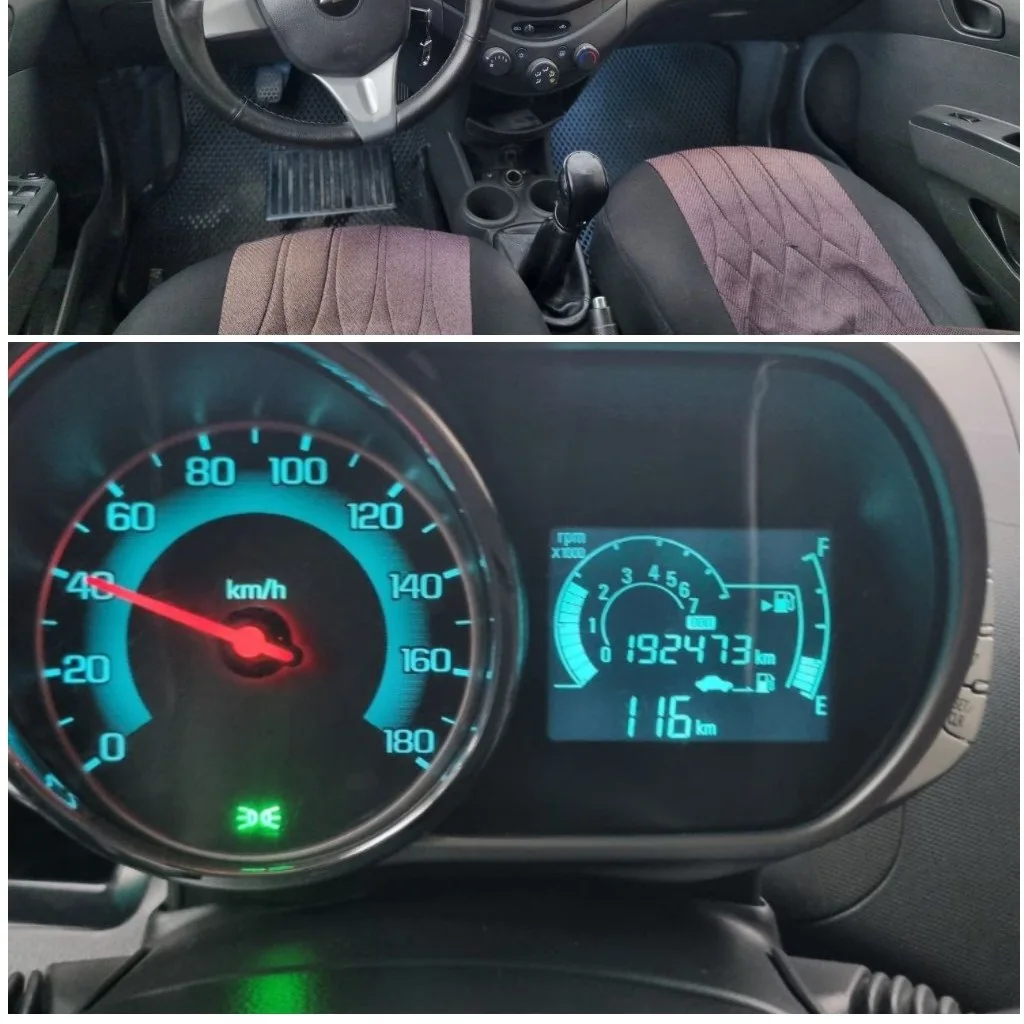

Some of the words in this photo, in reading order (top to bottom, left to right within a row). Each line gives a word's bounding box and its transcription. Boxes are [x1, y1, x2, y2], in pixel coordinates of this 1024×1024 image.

[186, 457, 236, 487] 80
[268, 456, 328, 486] 100
[106, 502, 156, 532] 60
[348, 502, 403, 530] 120
[557, 532, 586, 546] rpm
[816, 537, 830, 557] F
[621, 567, 633, 584] 3
[648, 564, 660, 581] 4
[666, 571, 677, 588] 5
[66, 571, 115, 600] 40
[226, 579, 287, 600] km/h
[389, 572, 443, 600] 140
[598, 584, 609, 601] 2
[678, 581, 690, 598] 6
[689, 597, 700, 614] 7
[588, 617, 597, 634] 1
[401, 647, 452, 673] 160
[600, 646, 612, 663] 0
[626, 634, 752, 666] 192473
[755, 649, 777, 666] km
[62, 654, 111, 684] 20
[626, 695, 692, 739] 116
[696, 719, 717, 736] km
[815, 695, 828, 716] E
[99, 732, 126, 762] 0
[384, 729, 436, 754] 180
